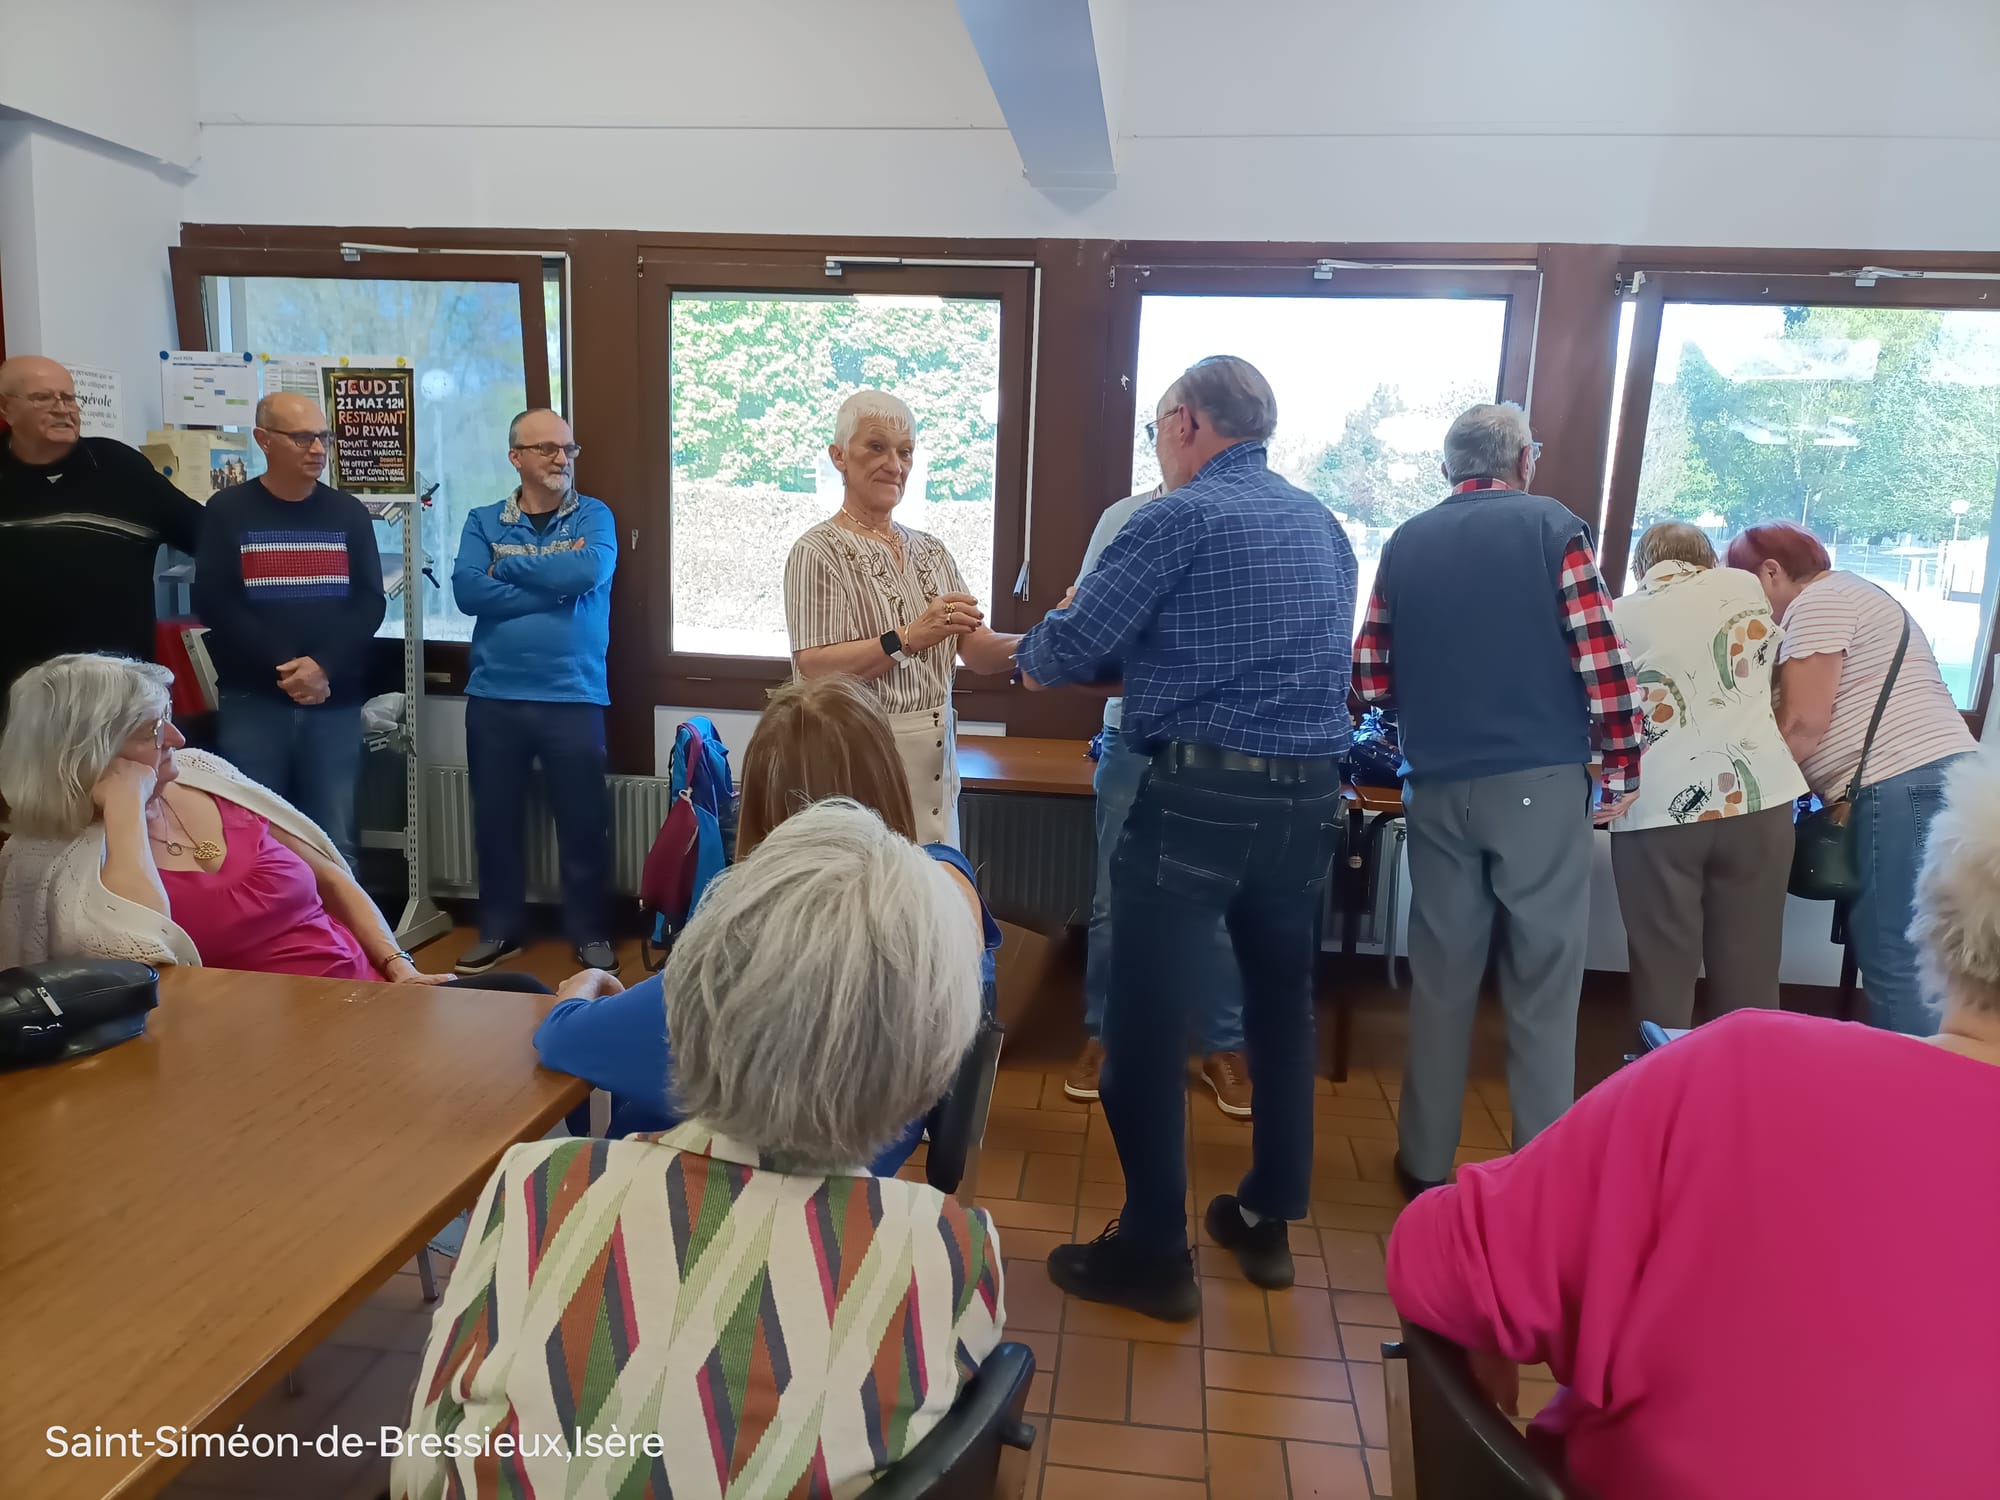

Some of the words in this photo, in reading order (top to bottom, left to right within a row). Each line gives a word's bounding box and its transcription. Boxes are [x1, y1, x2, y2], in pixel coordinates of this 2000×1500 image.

[336, 380, 400, 395] JEUDI
[336, 397, 353, 410] 21
[355, 398, 384, 409] MAI
[386, 398, 405, 409] 12H
[338, 410, 406, 425] RESTAURANT
[345, 425, 359, 437] DU
[362, 425, 399, 437] RIVAL
[338, 440, 368, 448] TOMATE
[372, 440, 400, 449] MOZZA
[340, 449, 371, 457] PORCELET
